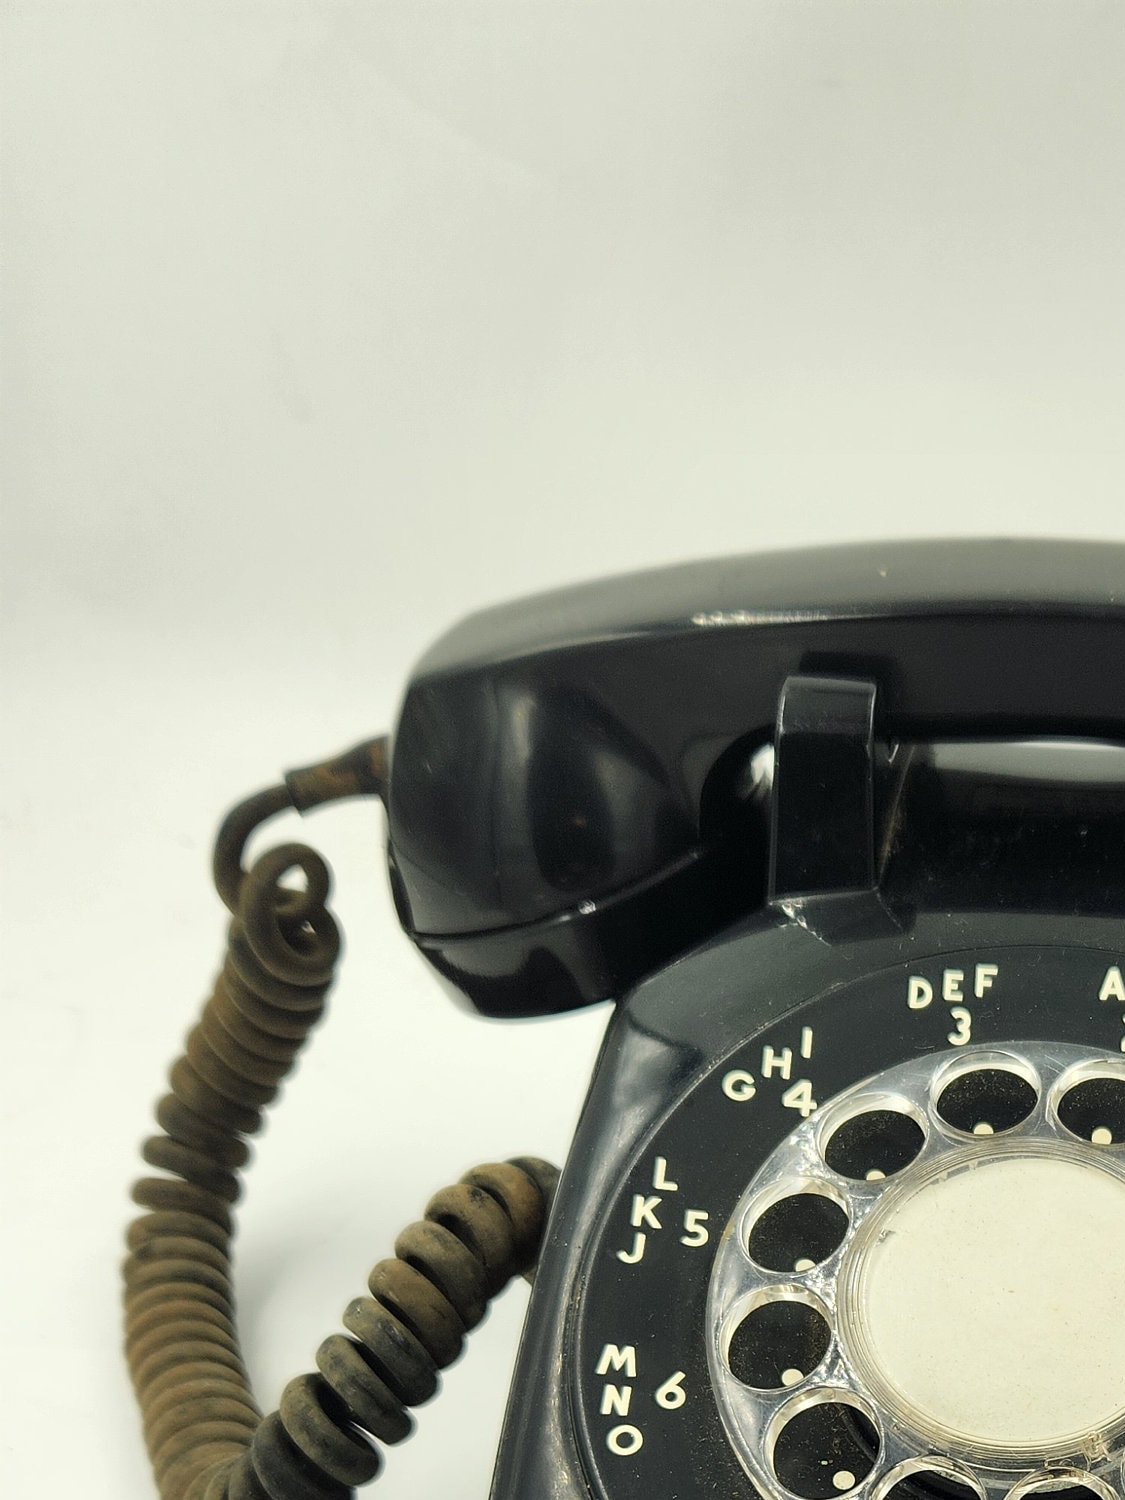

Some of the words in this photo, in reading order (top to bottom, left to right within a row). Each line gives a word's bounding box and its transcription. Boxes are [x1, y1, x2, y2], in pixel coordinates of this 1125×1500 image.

[907, 963, 999, 1010] DEF
[947, 1006, 972, 1047] 3
[781, 1079, 818, 1117] 4
[680, 1208, 709, 1247] 5
[654, 1370, 687, 1410] 6
